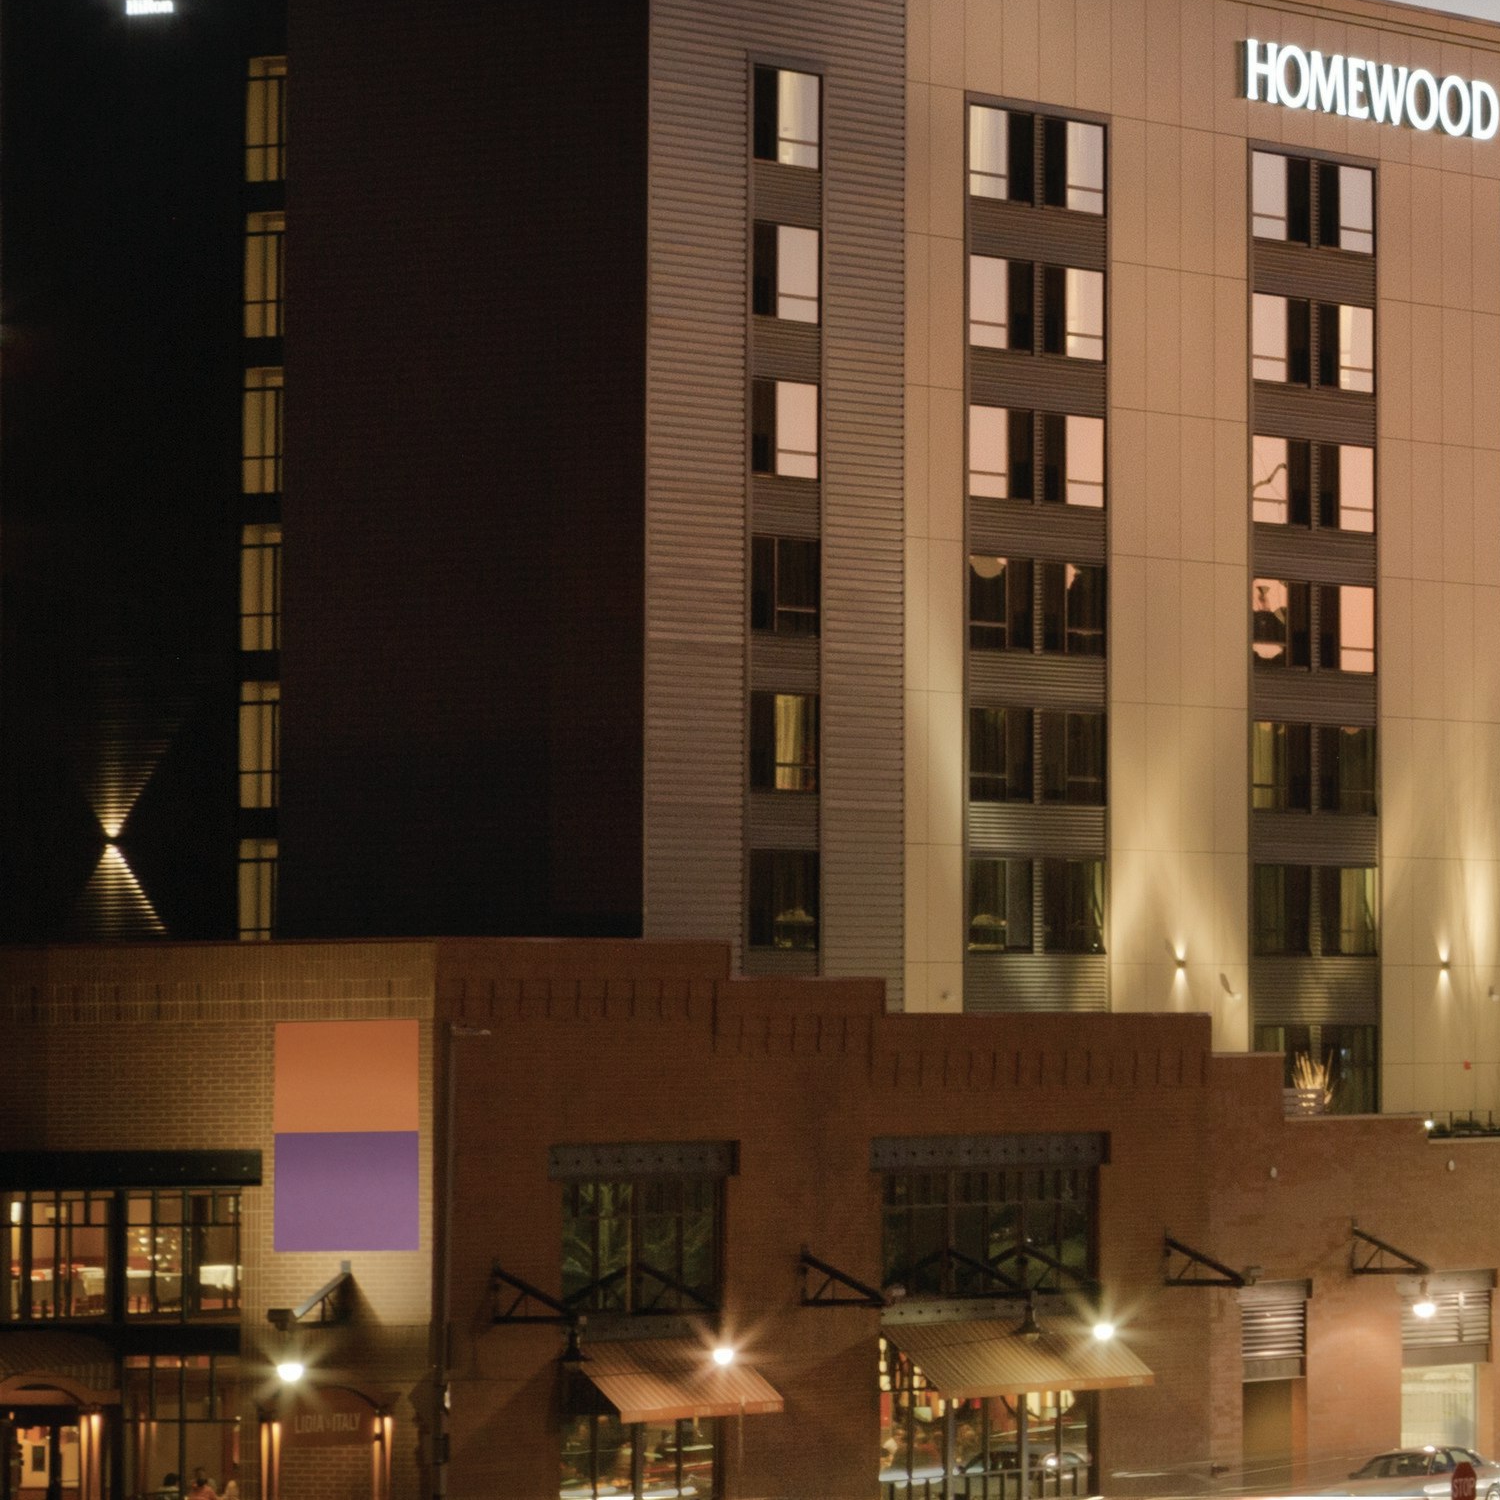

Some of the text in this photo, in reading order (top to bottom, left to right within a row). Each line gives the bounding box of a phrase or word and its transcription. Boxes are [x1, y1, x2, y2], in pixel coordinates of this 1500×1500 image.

[1246, 38, 1500, 141] HOMEWOOD
[333, 1412, 361, 1432] ITALY
[1453, 1477, 1475, 1498] STOP
